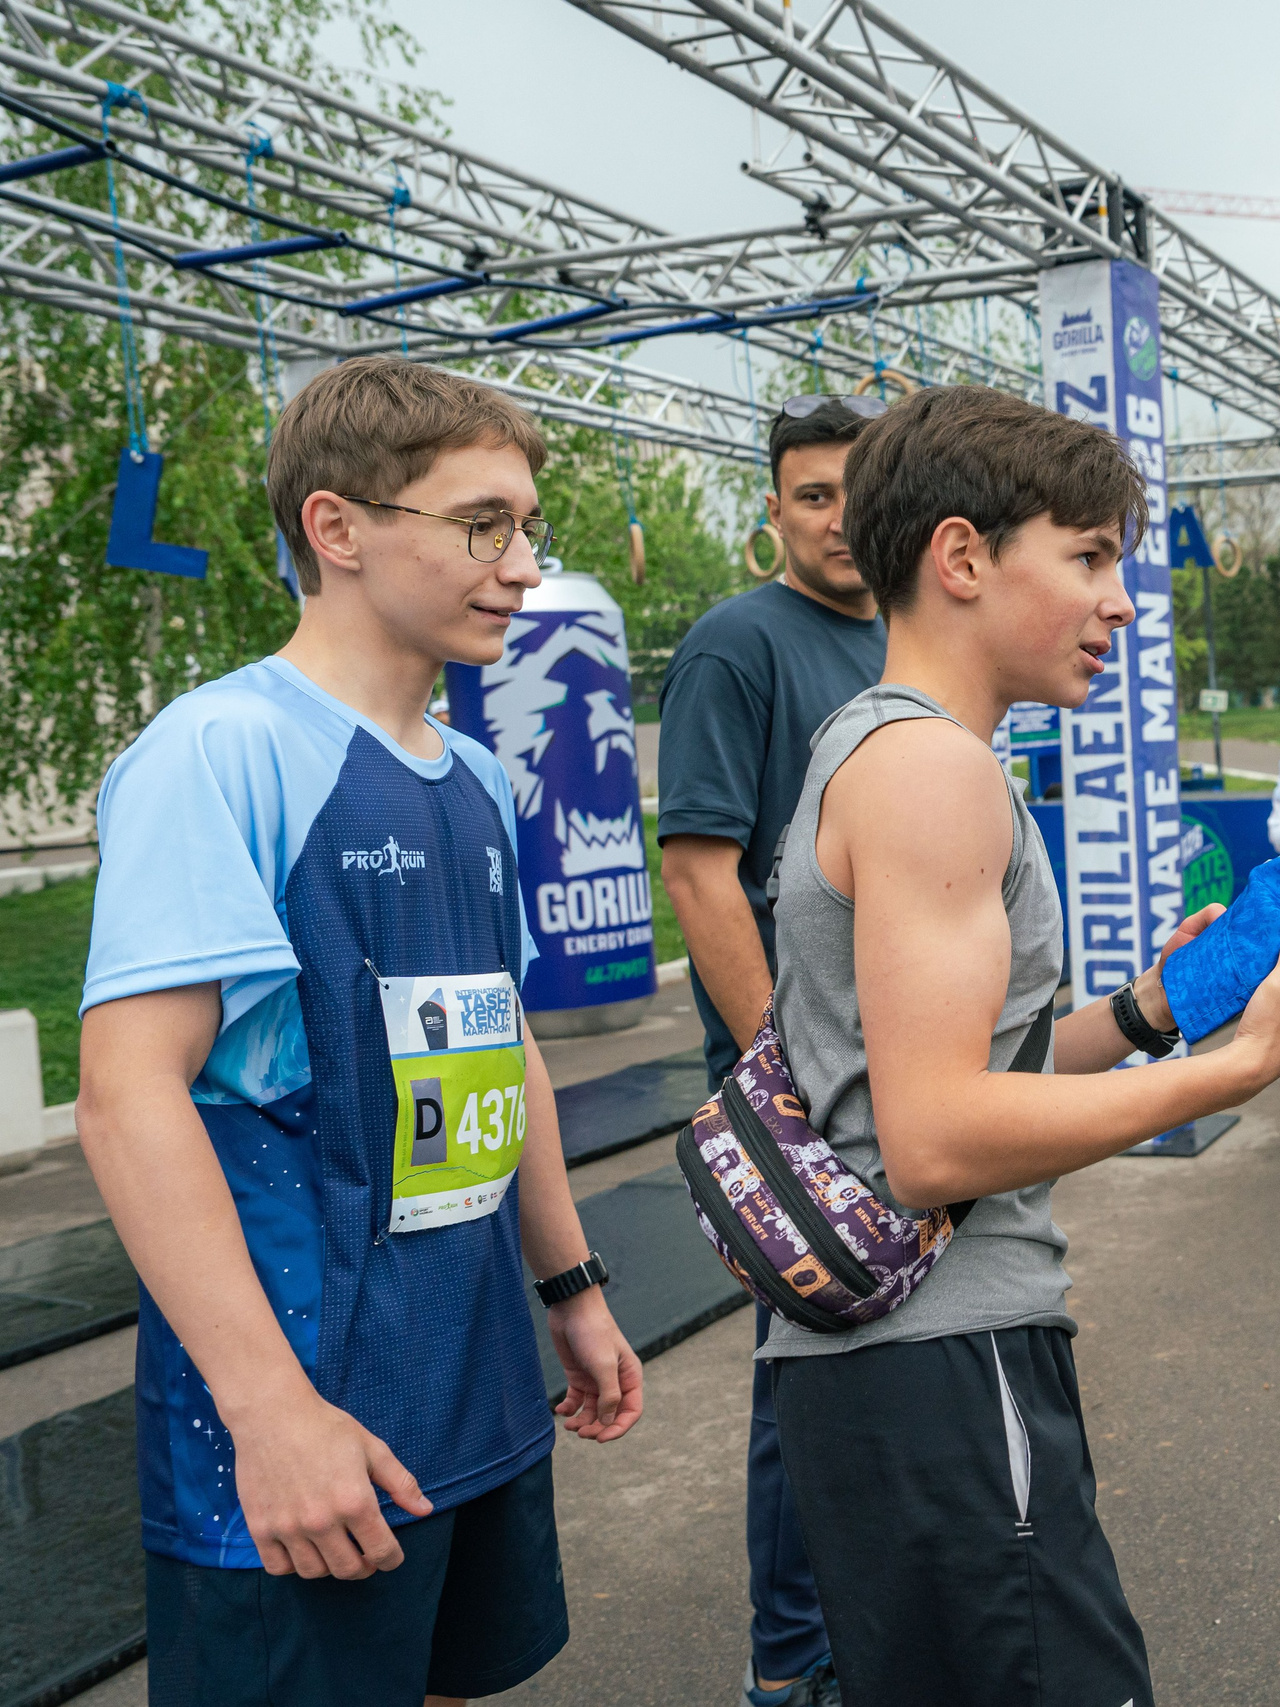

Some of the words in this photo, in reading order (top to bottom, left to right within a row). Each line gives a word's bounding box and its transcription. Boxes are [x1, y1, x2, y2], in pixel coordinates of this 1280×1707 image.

[1053, 325, 1104, 350] GORILLA
[1136, 592, 1176, 742] MAN
[341, 850, 384, 870] PRO
[400, 850, 426, 869] RUN
[564, 929, 626, 956] ENERGY
[457, 991, 509, 1013] TASH
[460, 1008, 506, 1030] KENT
[463, 1023, 507, 1037] MARATHON
[415, 1098, 442, 1140] D
[456, 1082, 526, 1154] 4376
